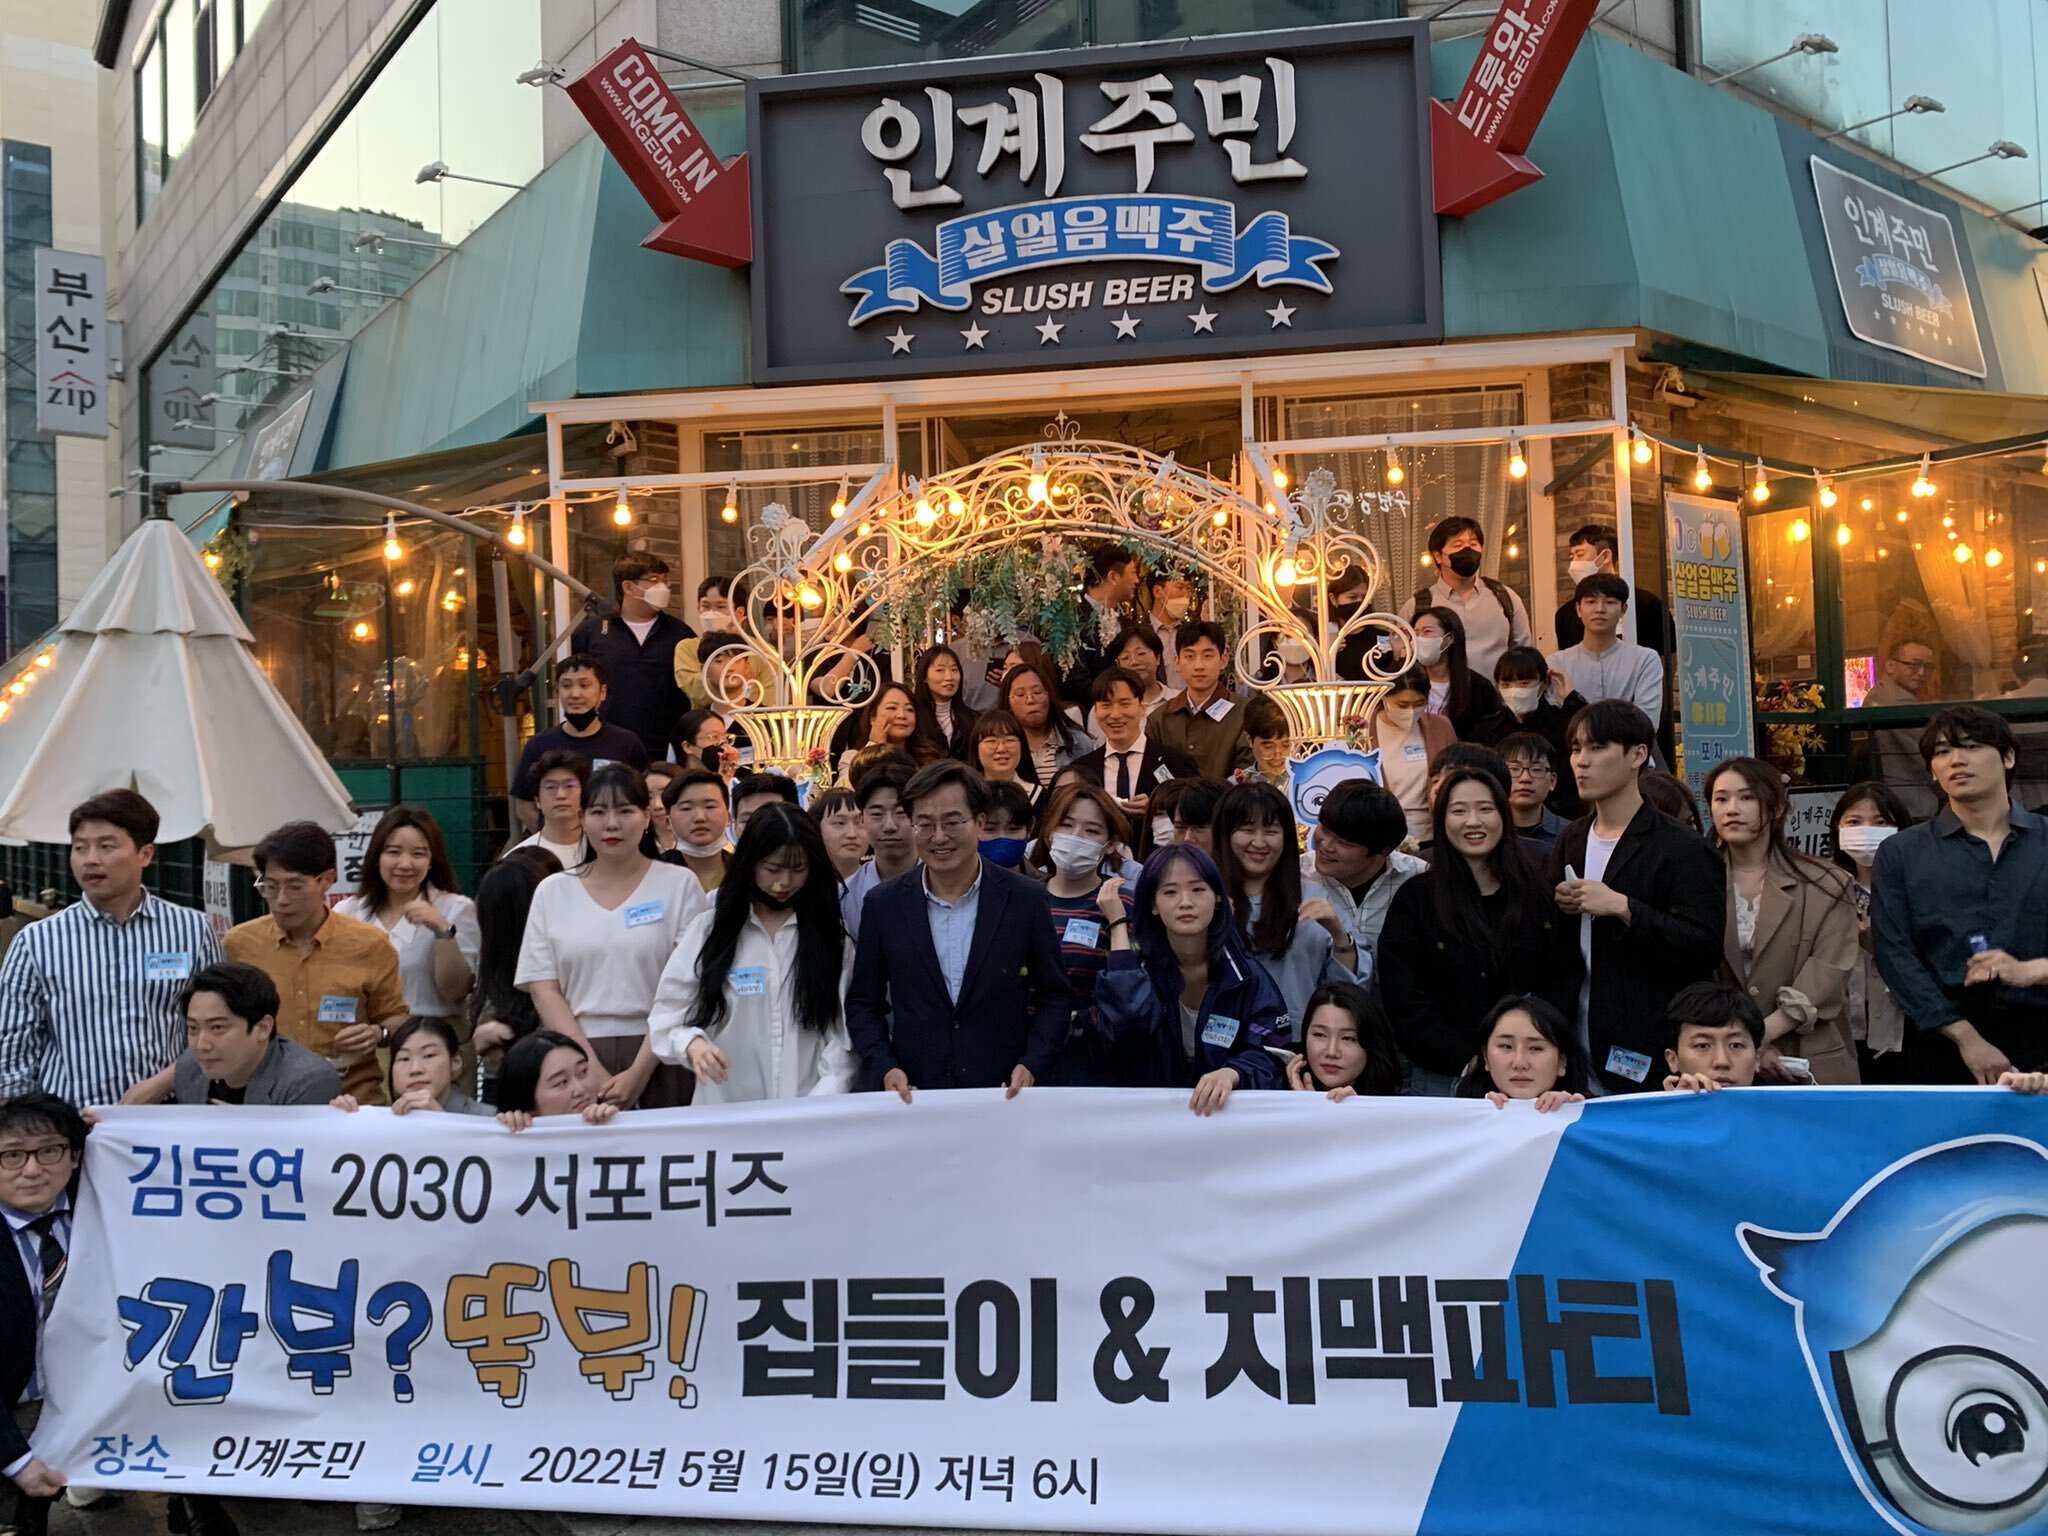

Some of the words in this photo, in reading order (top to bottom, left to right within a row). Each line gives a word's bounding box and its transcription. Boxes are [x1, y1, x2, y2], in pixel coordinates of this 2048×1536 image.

[613, 54, 691, 154] COME
[679, 148, 718, 193] IN
[861, 57, 1308, 209] 인계주민
[960, 205, 1215, 269] 살얼음맥주
[1844, 195, 1939, 272] 인계주민
[981, 280, 1094, 315] SLUSH
[1103, 273, 1196, 307] BEER
[1878, 257, 1929, 291] 살얼음맥주
[47, 268, 93, 354] 부산
[1881, 293, 1914, 318] SLUSH
[1915, 306, 1940, 328] BEER
[47, 381, 96, 415] zip
[1675, 560, 1738, 604] 살얼음맥주
[1686, 604, 1708, 620] SLUSH
[1710, 606, 1728, 622] BEER
[1683, 666, 1735, 704] 인계주민
[128, 1144, 307, 1222] 김동연
[331, 1152, 493, 1224] 2030
[515, 1150, 793, 1230] 서포터즈
[116, 1249, 433, 1407] 깐부?
[444, 1257, 708, 1409] 똑부!
[737, 1276, 1058, 1403] 집들이
[1093, 1276, 1171, 1405] &
[1205, 1274, 1691, 1416] 치맥파티
[207, 1436, 366, 1481] 인계주민
[519, 1446, 667, 1490] 2022년
[677, 1448, 746, 1493] 5월
[760, 1451, 921, 1500] 15일(일)
[935, 1454, 1015, 1503] 저녁
[1031, 1457, 1099, 1506] 6시
